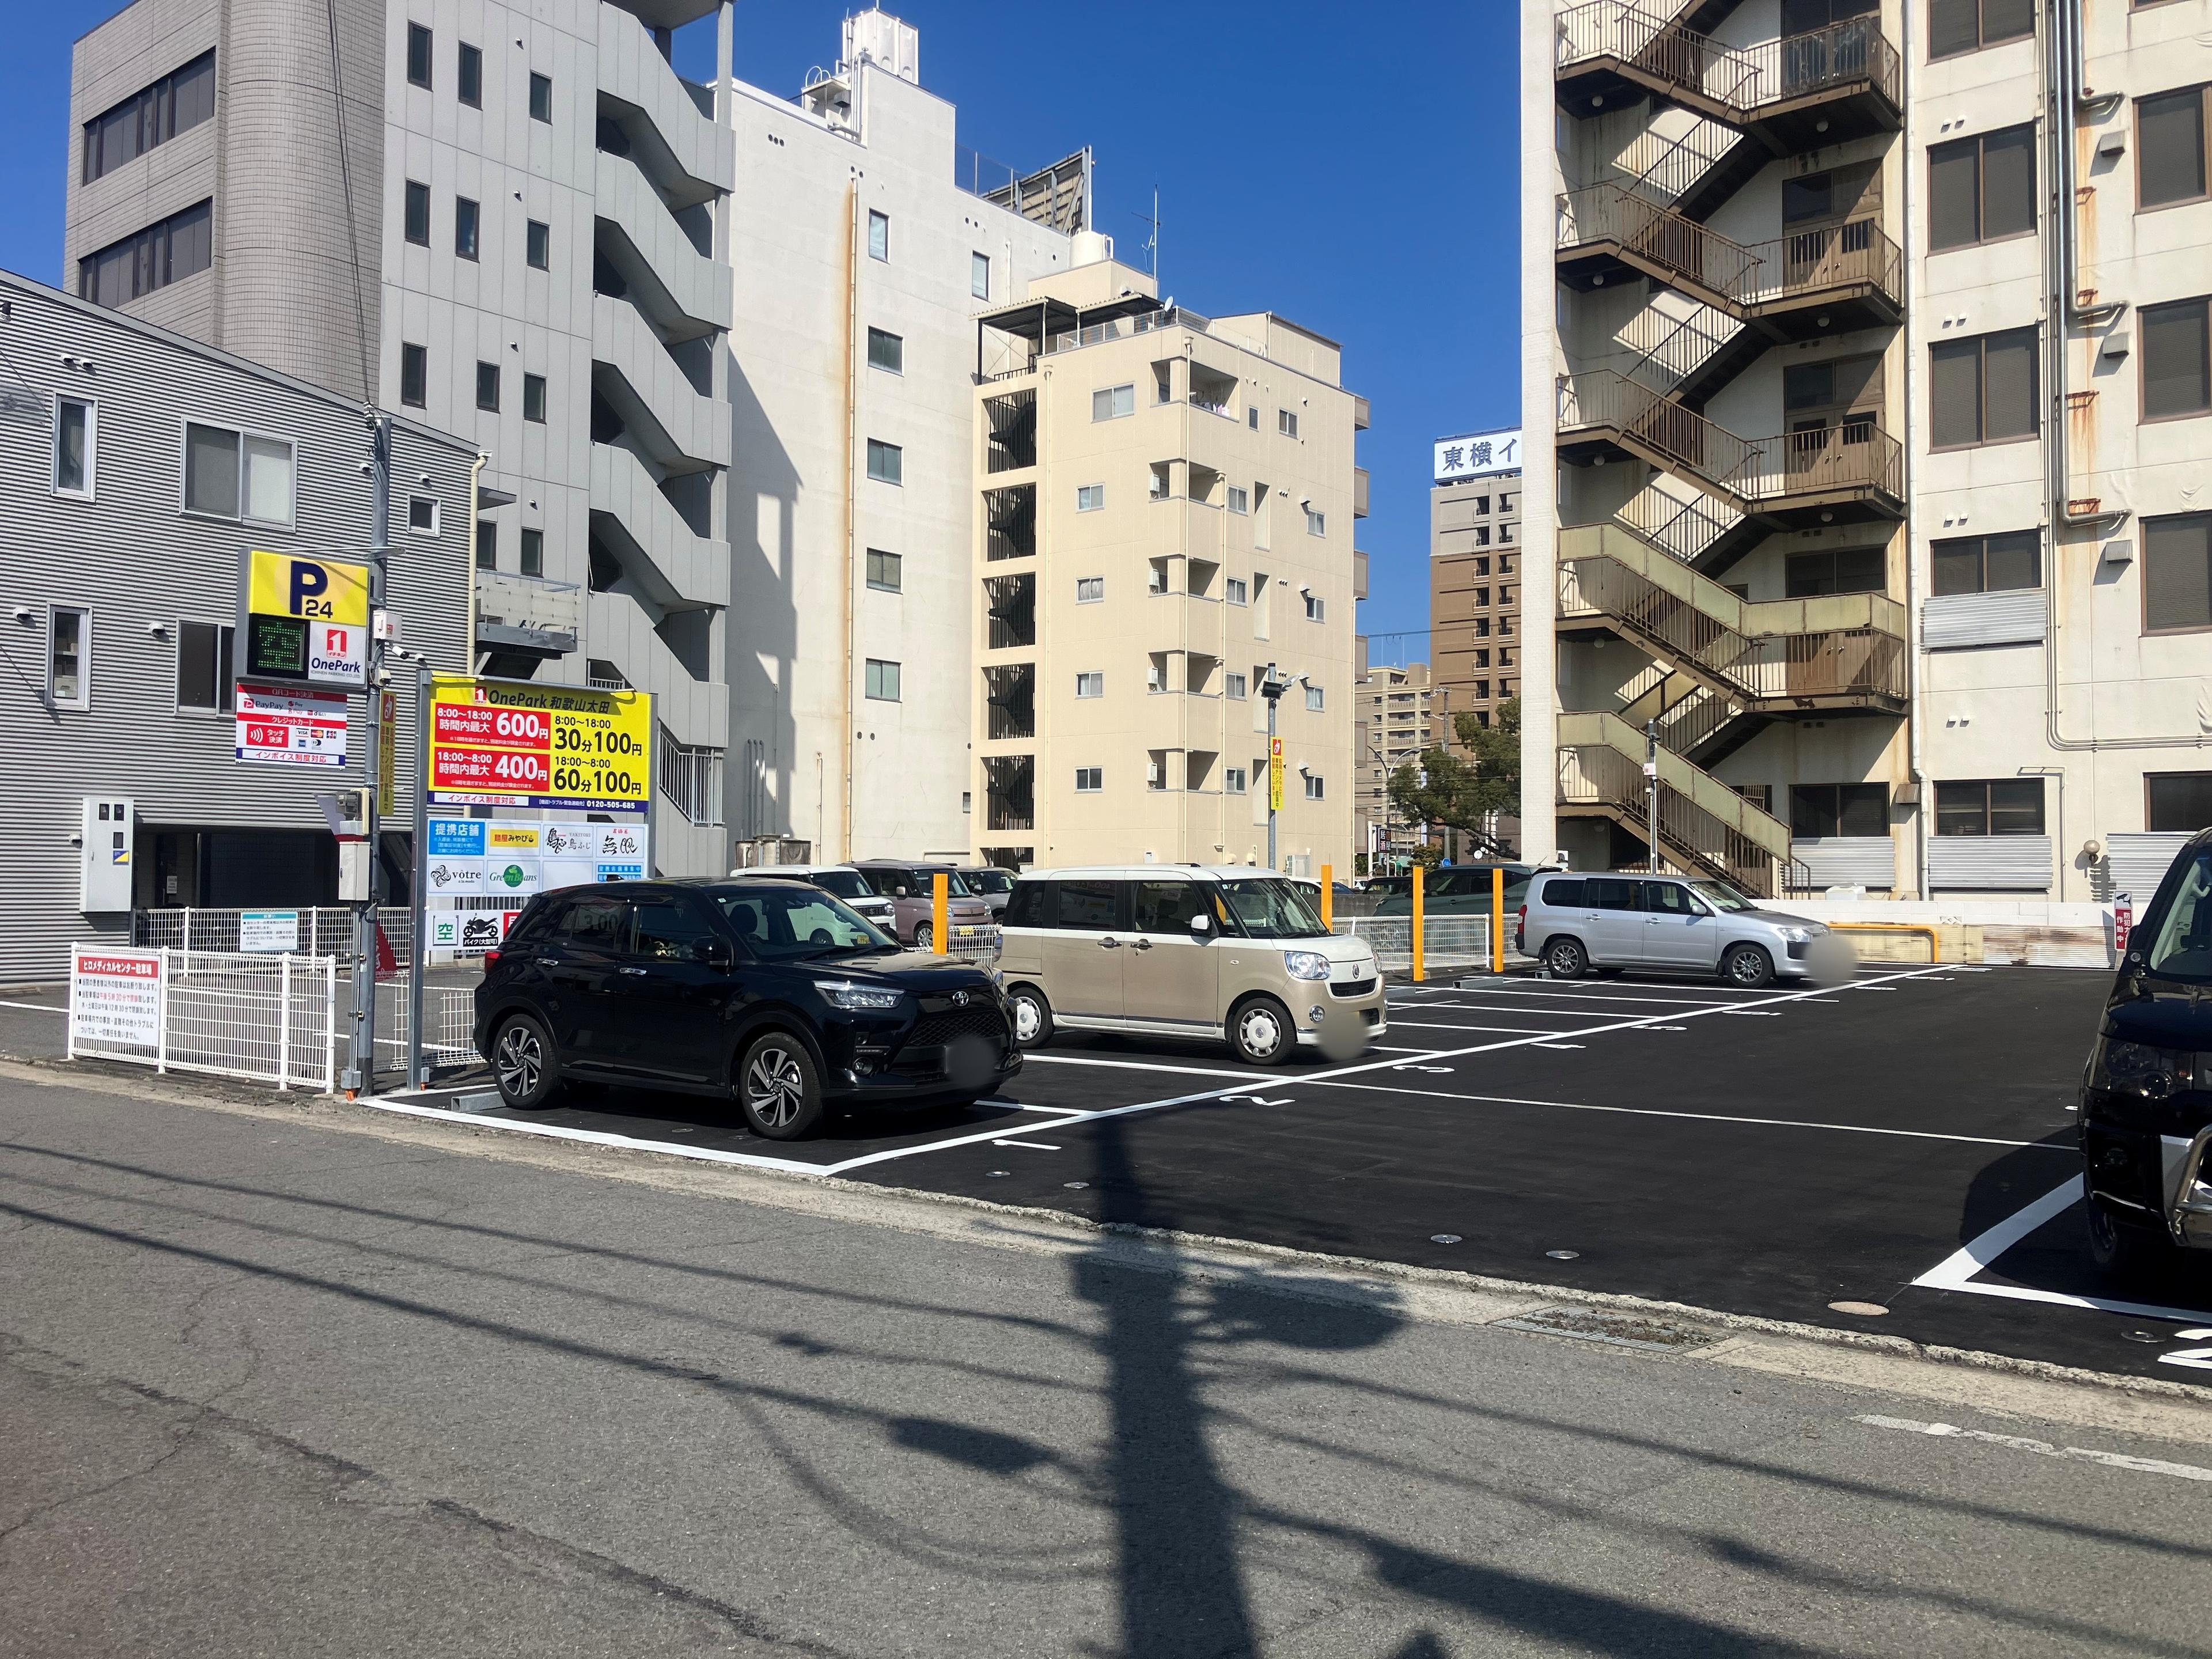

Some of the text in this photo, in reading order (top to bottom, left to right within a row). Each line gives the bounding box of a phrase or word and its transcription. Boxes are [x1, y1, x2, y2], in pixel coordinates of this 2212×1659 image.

[1443, 438, 1517, 471] 東横イ
[290, 560, 328, 615] P
[305, 599, 333, 619] 24
[312, 658, 361, 673] OnePark
[256, 700, 283, 710] PayPay
[489, 690, 547, 709] OnePark
[550, 696, 610, 714] 和歌山太田
[272, 716, 314, 726] クレジットカード
[440, 712, 548, 740] 時間内最大 600円
[267, 729, 285, 737] タッチ
[256, 751, 327, 763] インボイス制度対応
[439, 755, 547, 781] 時間内最大 400円
[448, 794, 516, 805] インボイス制度対応
[587, 800, 635, 809] 0120-505-685
[435, 823, 479, 836] 提携店舗
[438, 923, 453, 940] 空
[84, 960, 152, 975] ヒロメディカルセンター駐車場
